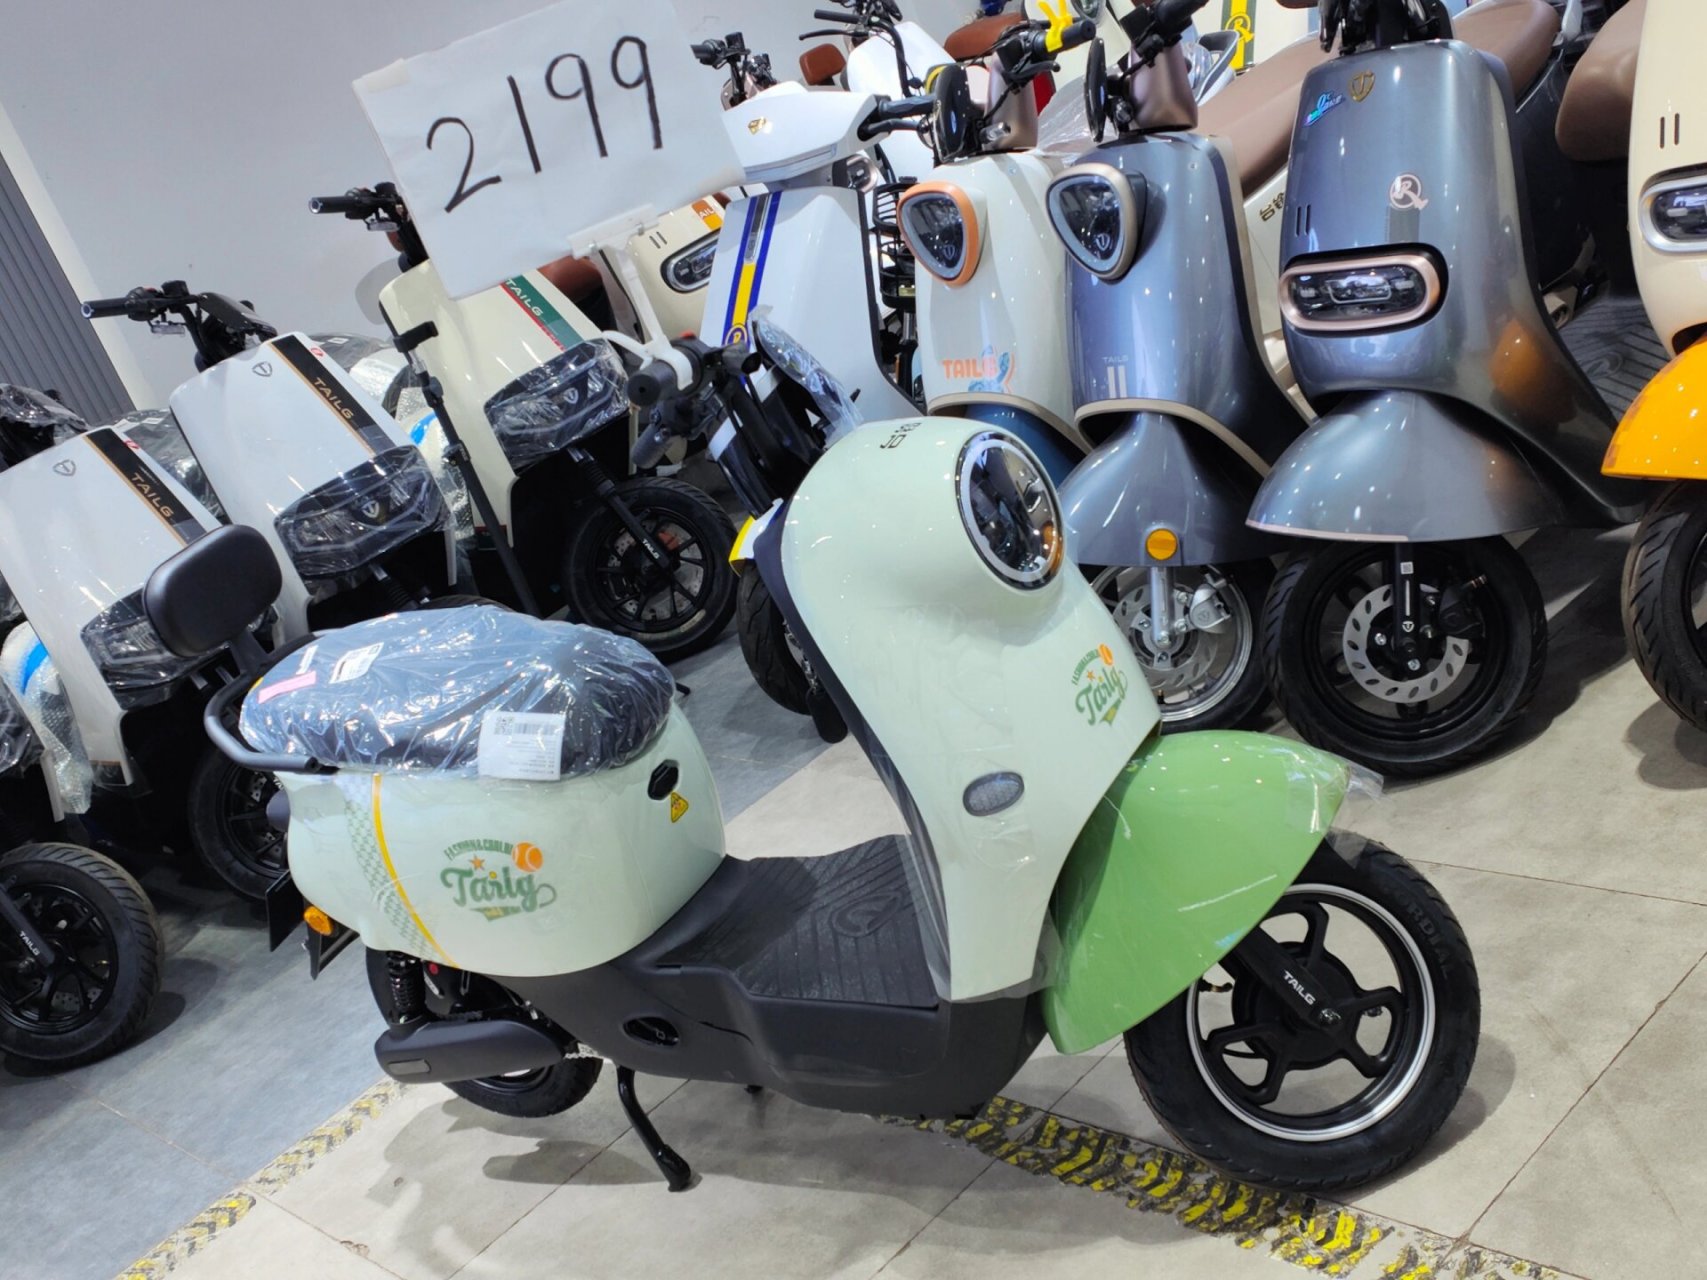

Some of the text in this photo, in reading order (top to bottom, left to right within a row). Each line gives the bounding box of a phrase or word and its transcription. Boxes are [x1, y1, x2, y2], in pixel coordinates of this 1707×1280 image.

[427, 35, 663, 213] 2199
[506, 278, 544, 317] TAILG
[314, 377, 354, 419] TAILG
[132, 472, 174, 517] TAILG
[20, 930, 40, 956] TAILG
[1283, 970, 1316, 1005] TAILG
